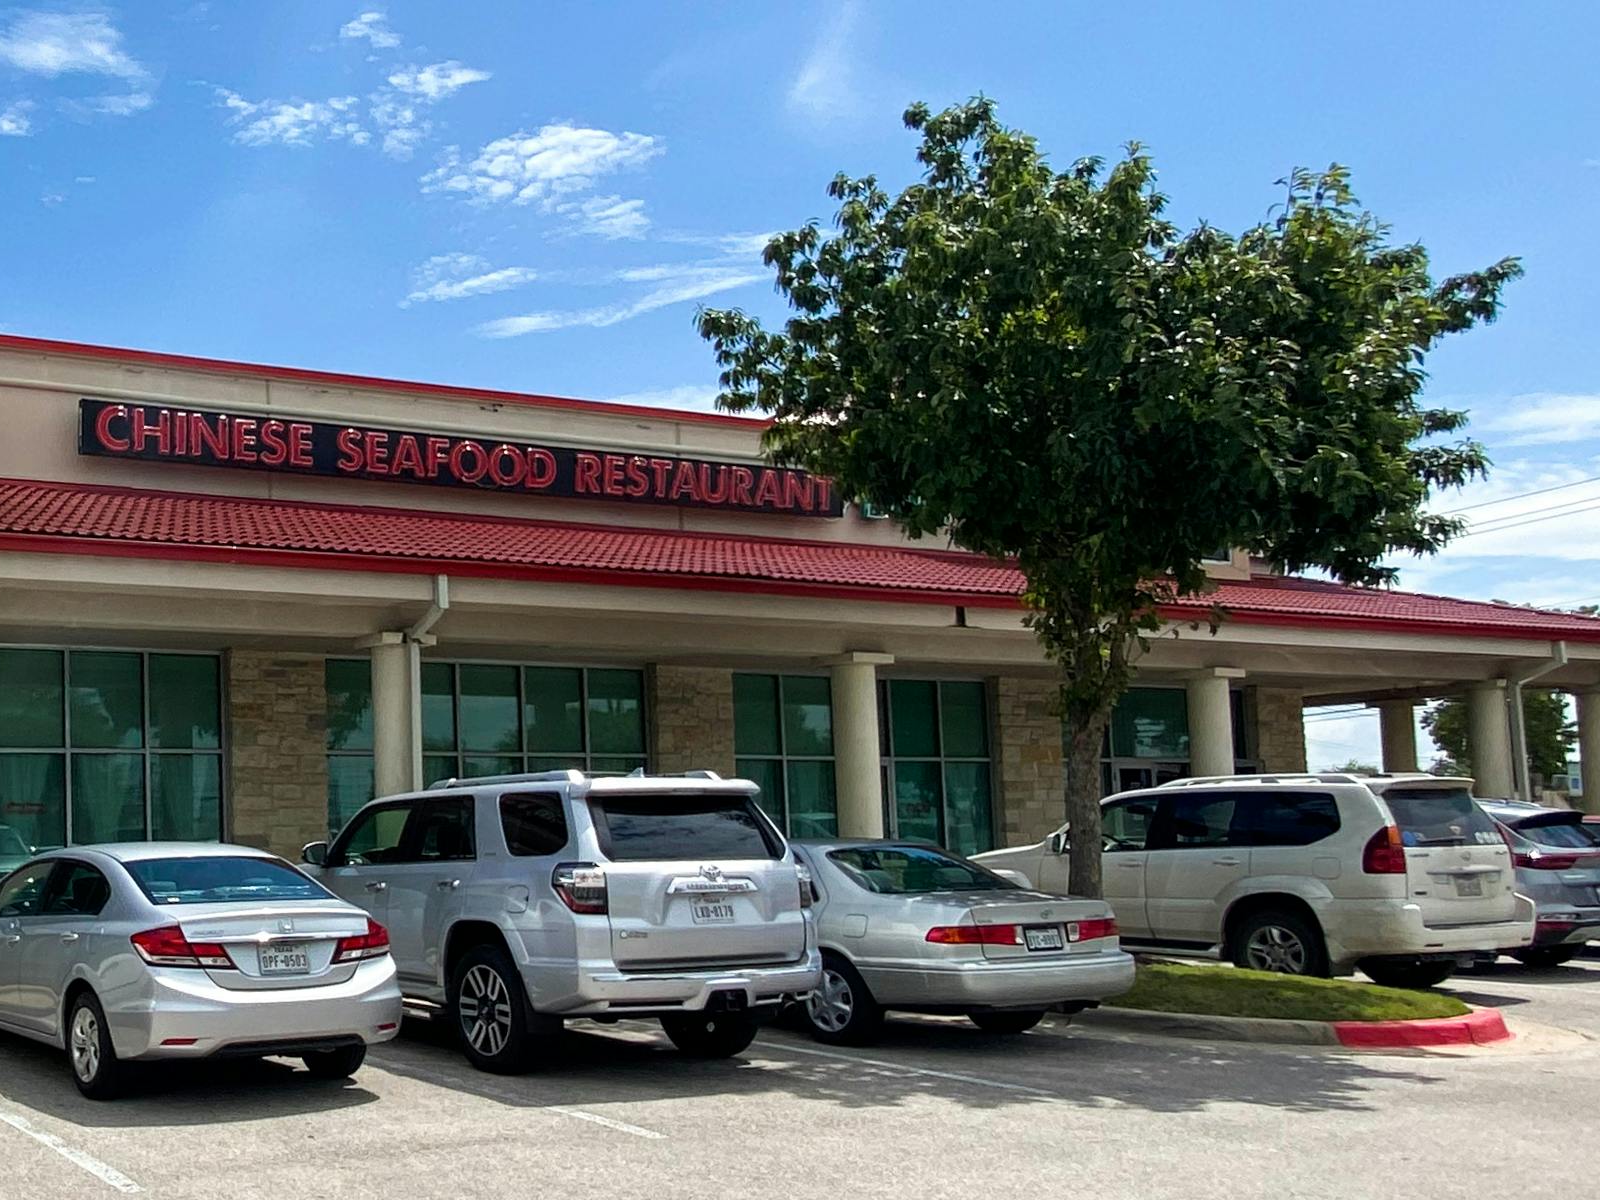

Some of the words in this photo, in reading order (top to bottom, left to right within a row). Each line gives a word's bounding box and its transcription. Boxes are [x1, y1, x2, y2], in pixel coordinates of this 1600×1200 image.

[95, 404, 314, 466] CHINESE
[336, 427, 558, 489] SEAFOOD
[573, 452, 835, 512] RESTAURANT
